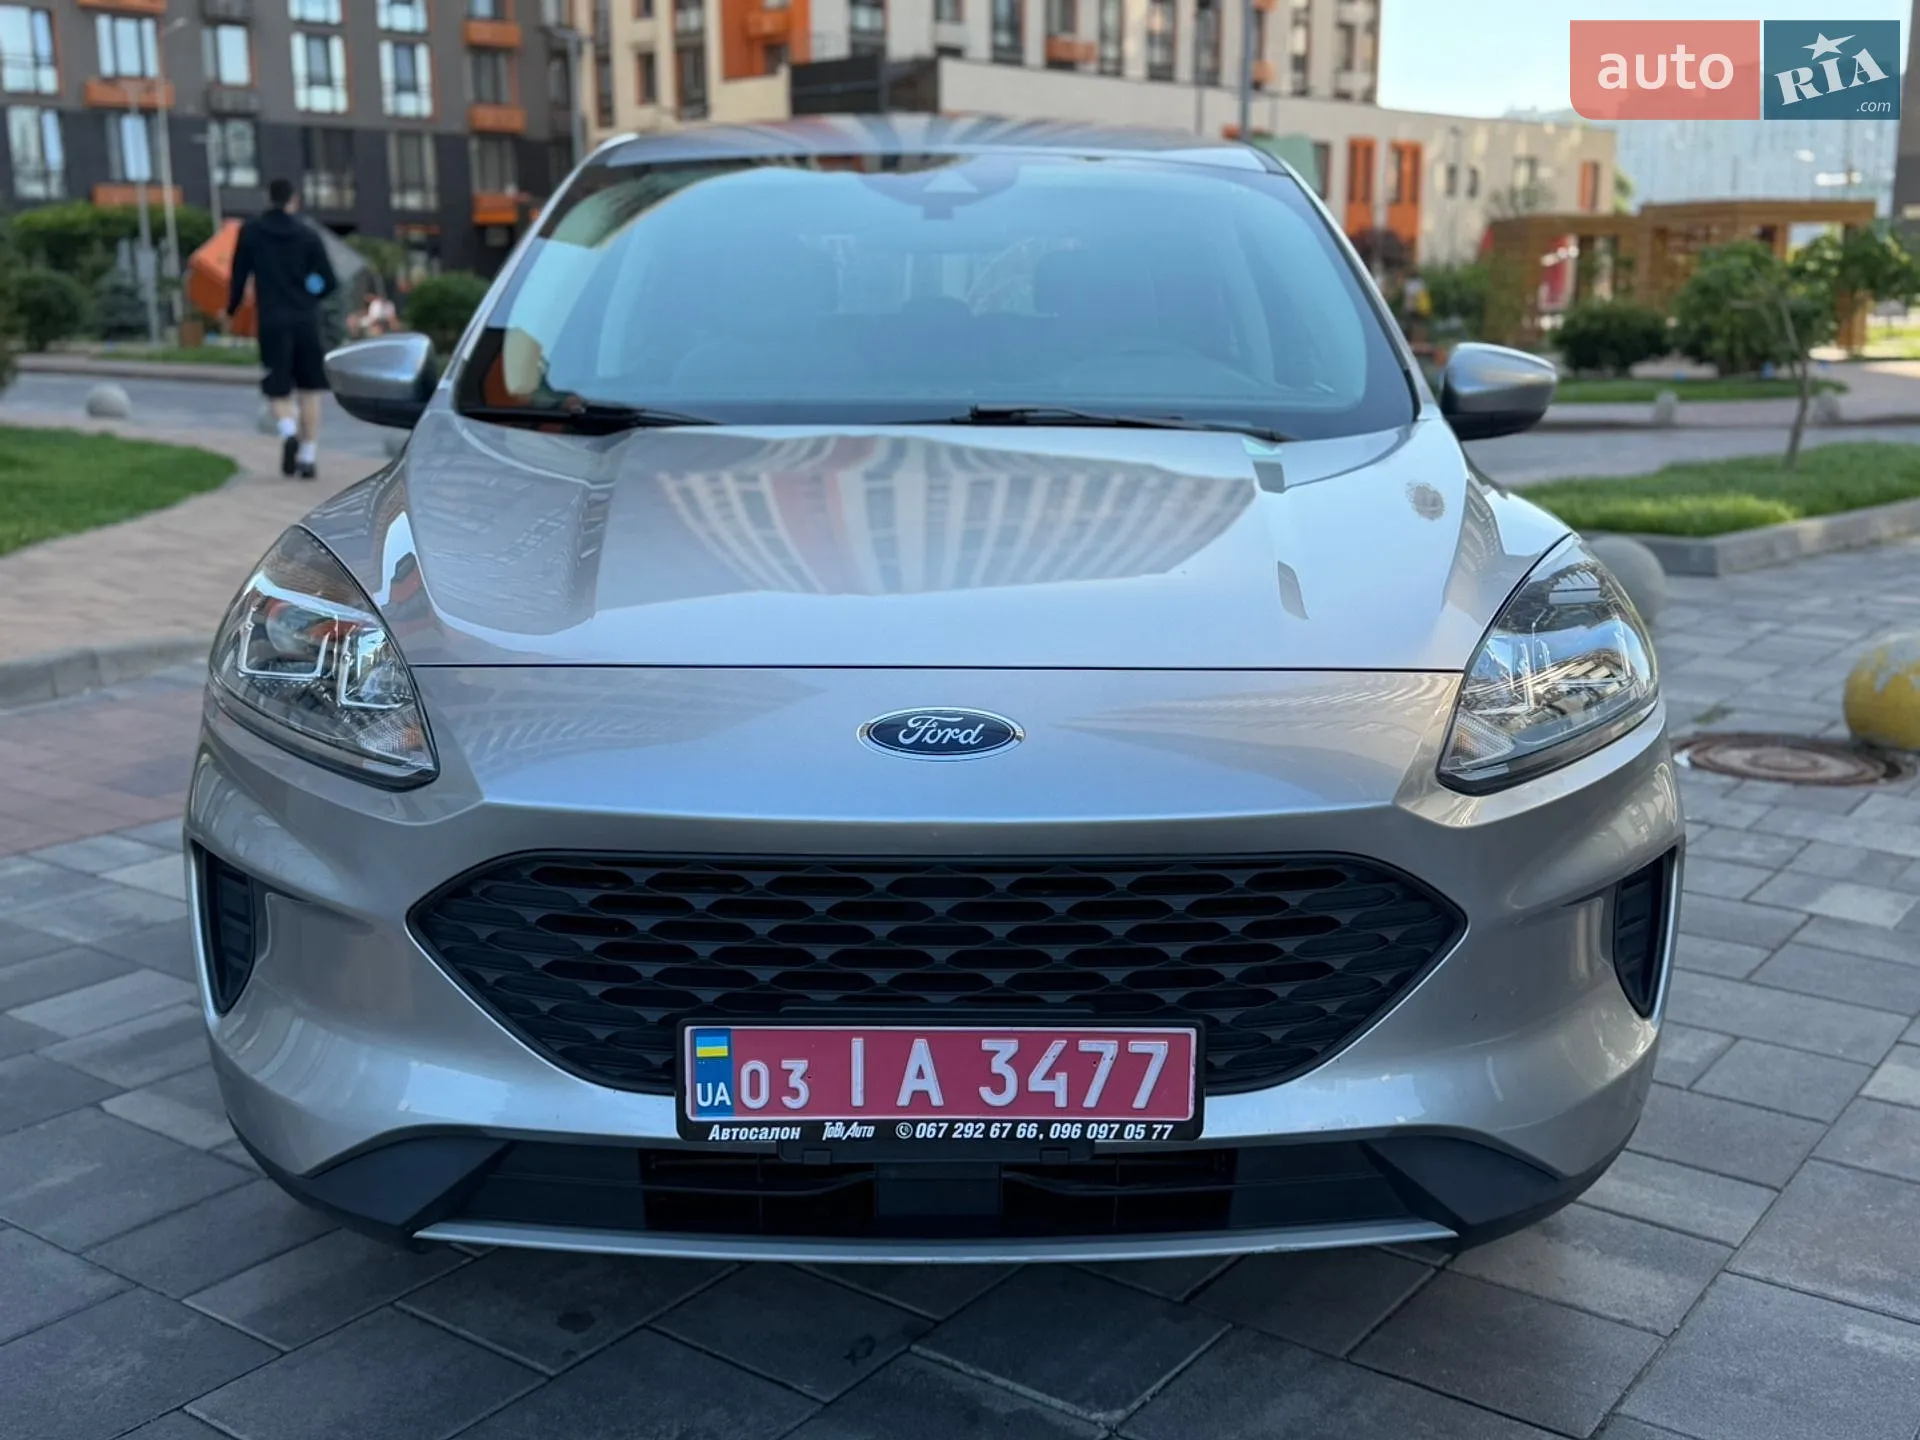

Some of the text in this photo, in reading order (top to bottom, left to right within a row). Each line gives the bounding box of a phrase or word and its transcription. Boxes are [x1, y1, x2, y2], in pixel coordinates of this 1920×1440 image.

[898, 715, 985, 745] Ford
[740, 1060, 810, 1110] 03
[979, 1040, 1169, 1109] 3477
[696, 1083, 731, 1106] UA
[708, 1124, 801, 1141] Автосалон
[914, 1123, 948, 1139] 067
[952, 1123, 985, 1139] 292
[989, 1123, 1012, 1139] 67
[1049, 1124, 1081, 1139] 096
[1086, 1124, 1119, 1139] 097
[1123, 1124, 1146, 1140] 05
[1151, 1124, 1173, 1140] 77
